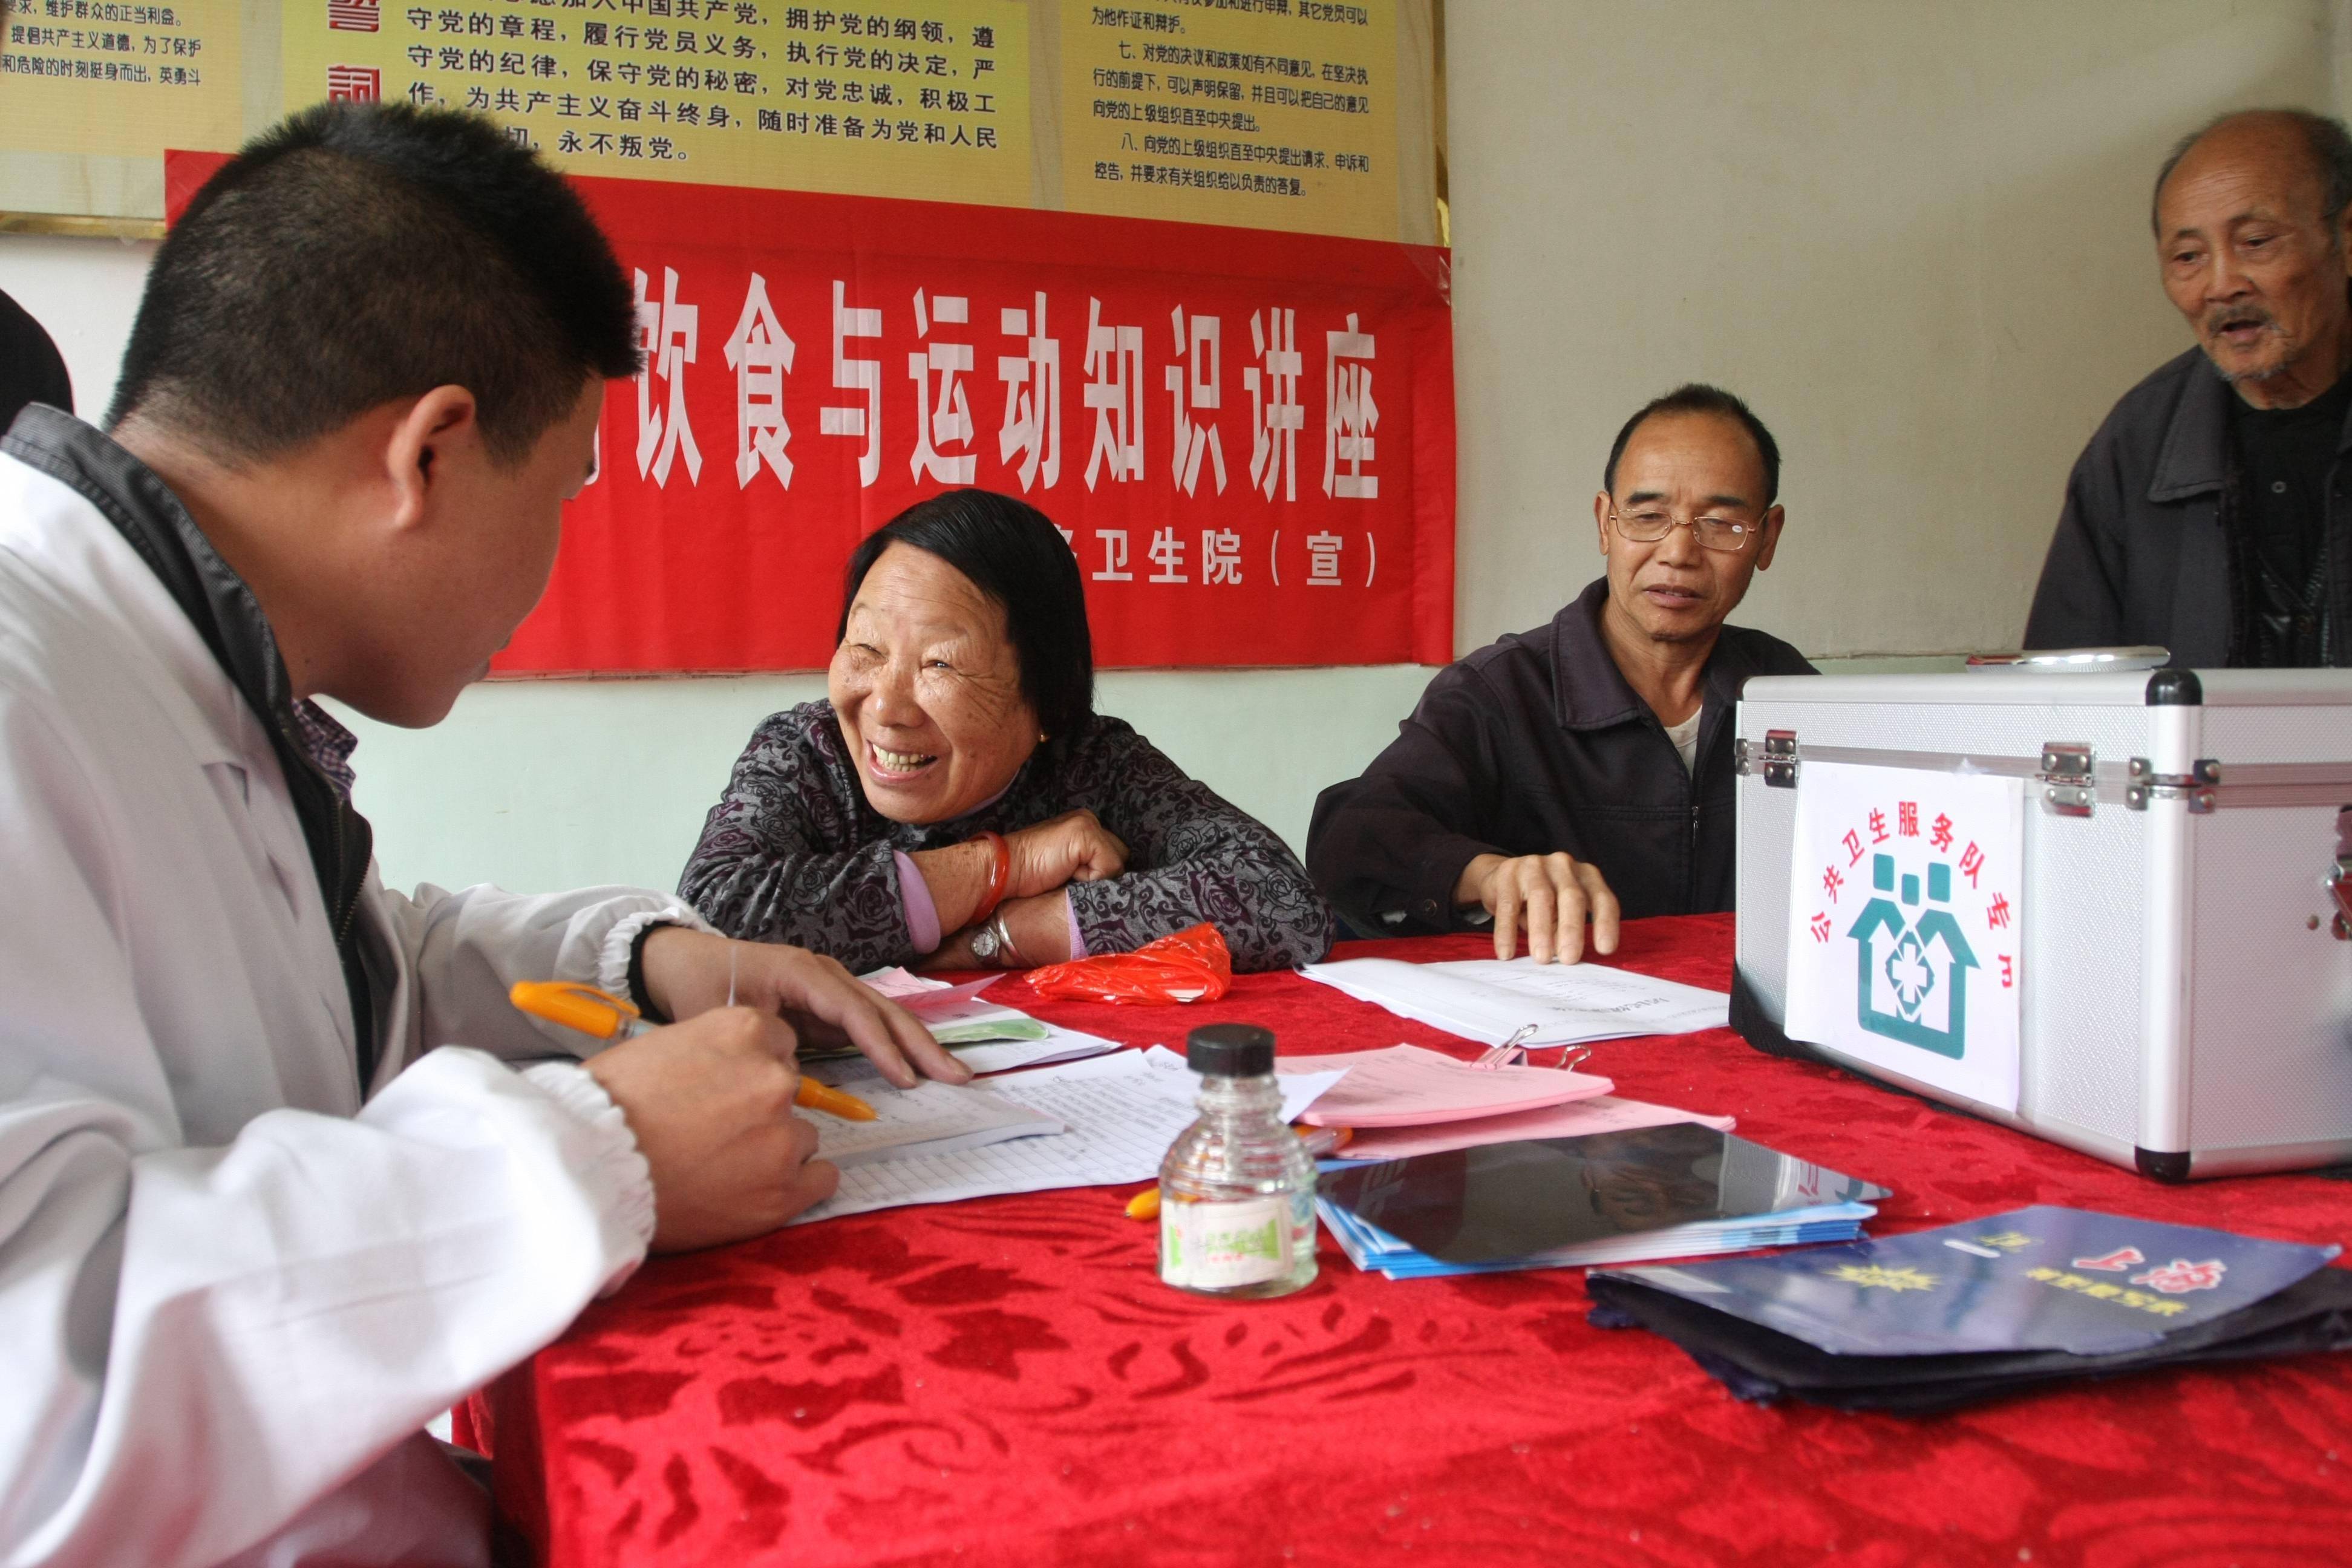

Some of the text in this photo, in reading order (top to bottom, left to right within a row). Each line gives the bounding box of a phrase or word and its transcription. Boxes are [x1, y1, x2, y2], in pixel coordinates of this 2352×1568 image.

[505, 0, 995, 48] 中国共产党，拥护党的纲领，遵
[1156, 0, 1368, 25] 加和进行申辩，其它党员可以
[11, 25, 201, 57] 提倡共产主义道德，为了保护
[585, 266, 1379, 501] 饮食与运动知识讲座
[1053, 523, 1376, 587] 卫生院（宣）
